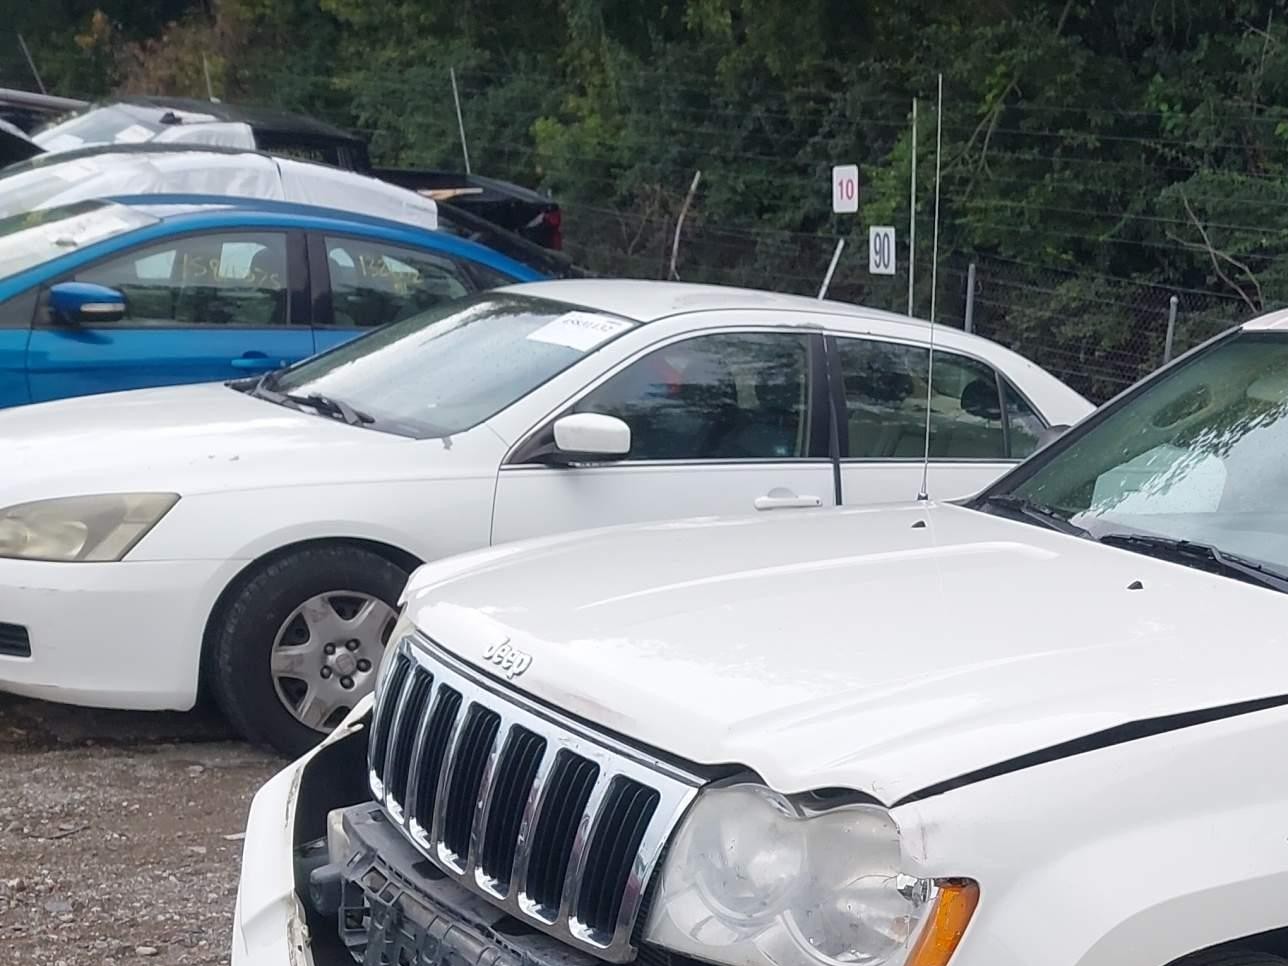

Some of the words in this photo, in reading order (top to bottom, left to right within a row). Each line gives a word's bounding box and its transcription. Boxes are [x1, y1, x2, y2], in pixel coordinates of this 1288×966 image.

[838, 179, 854, 200] 10
[874, 232, 890, 269] 90
[482, 635, 533, 681] Jeep
